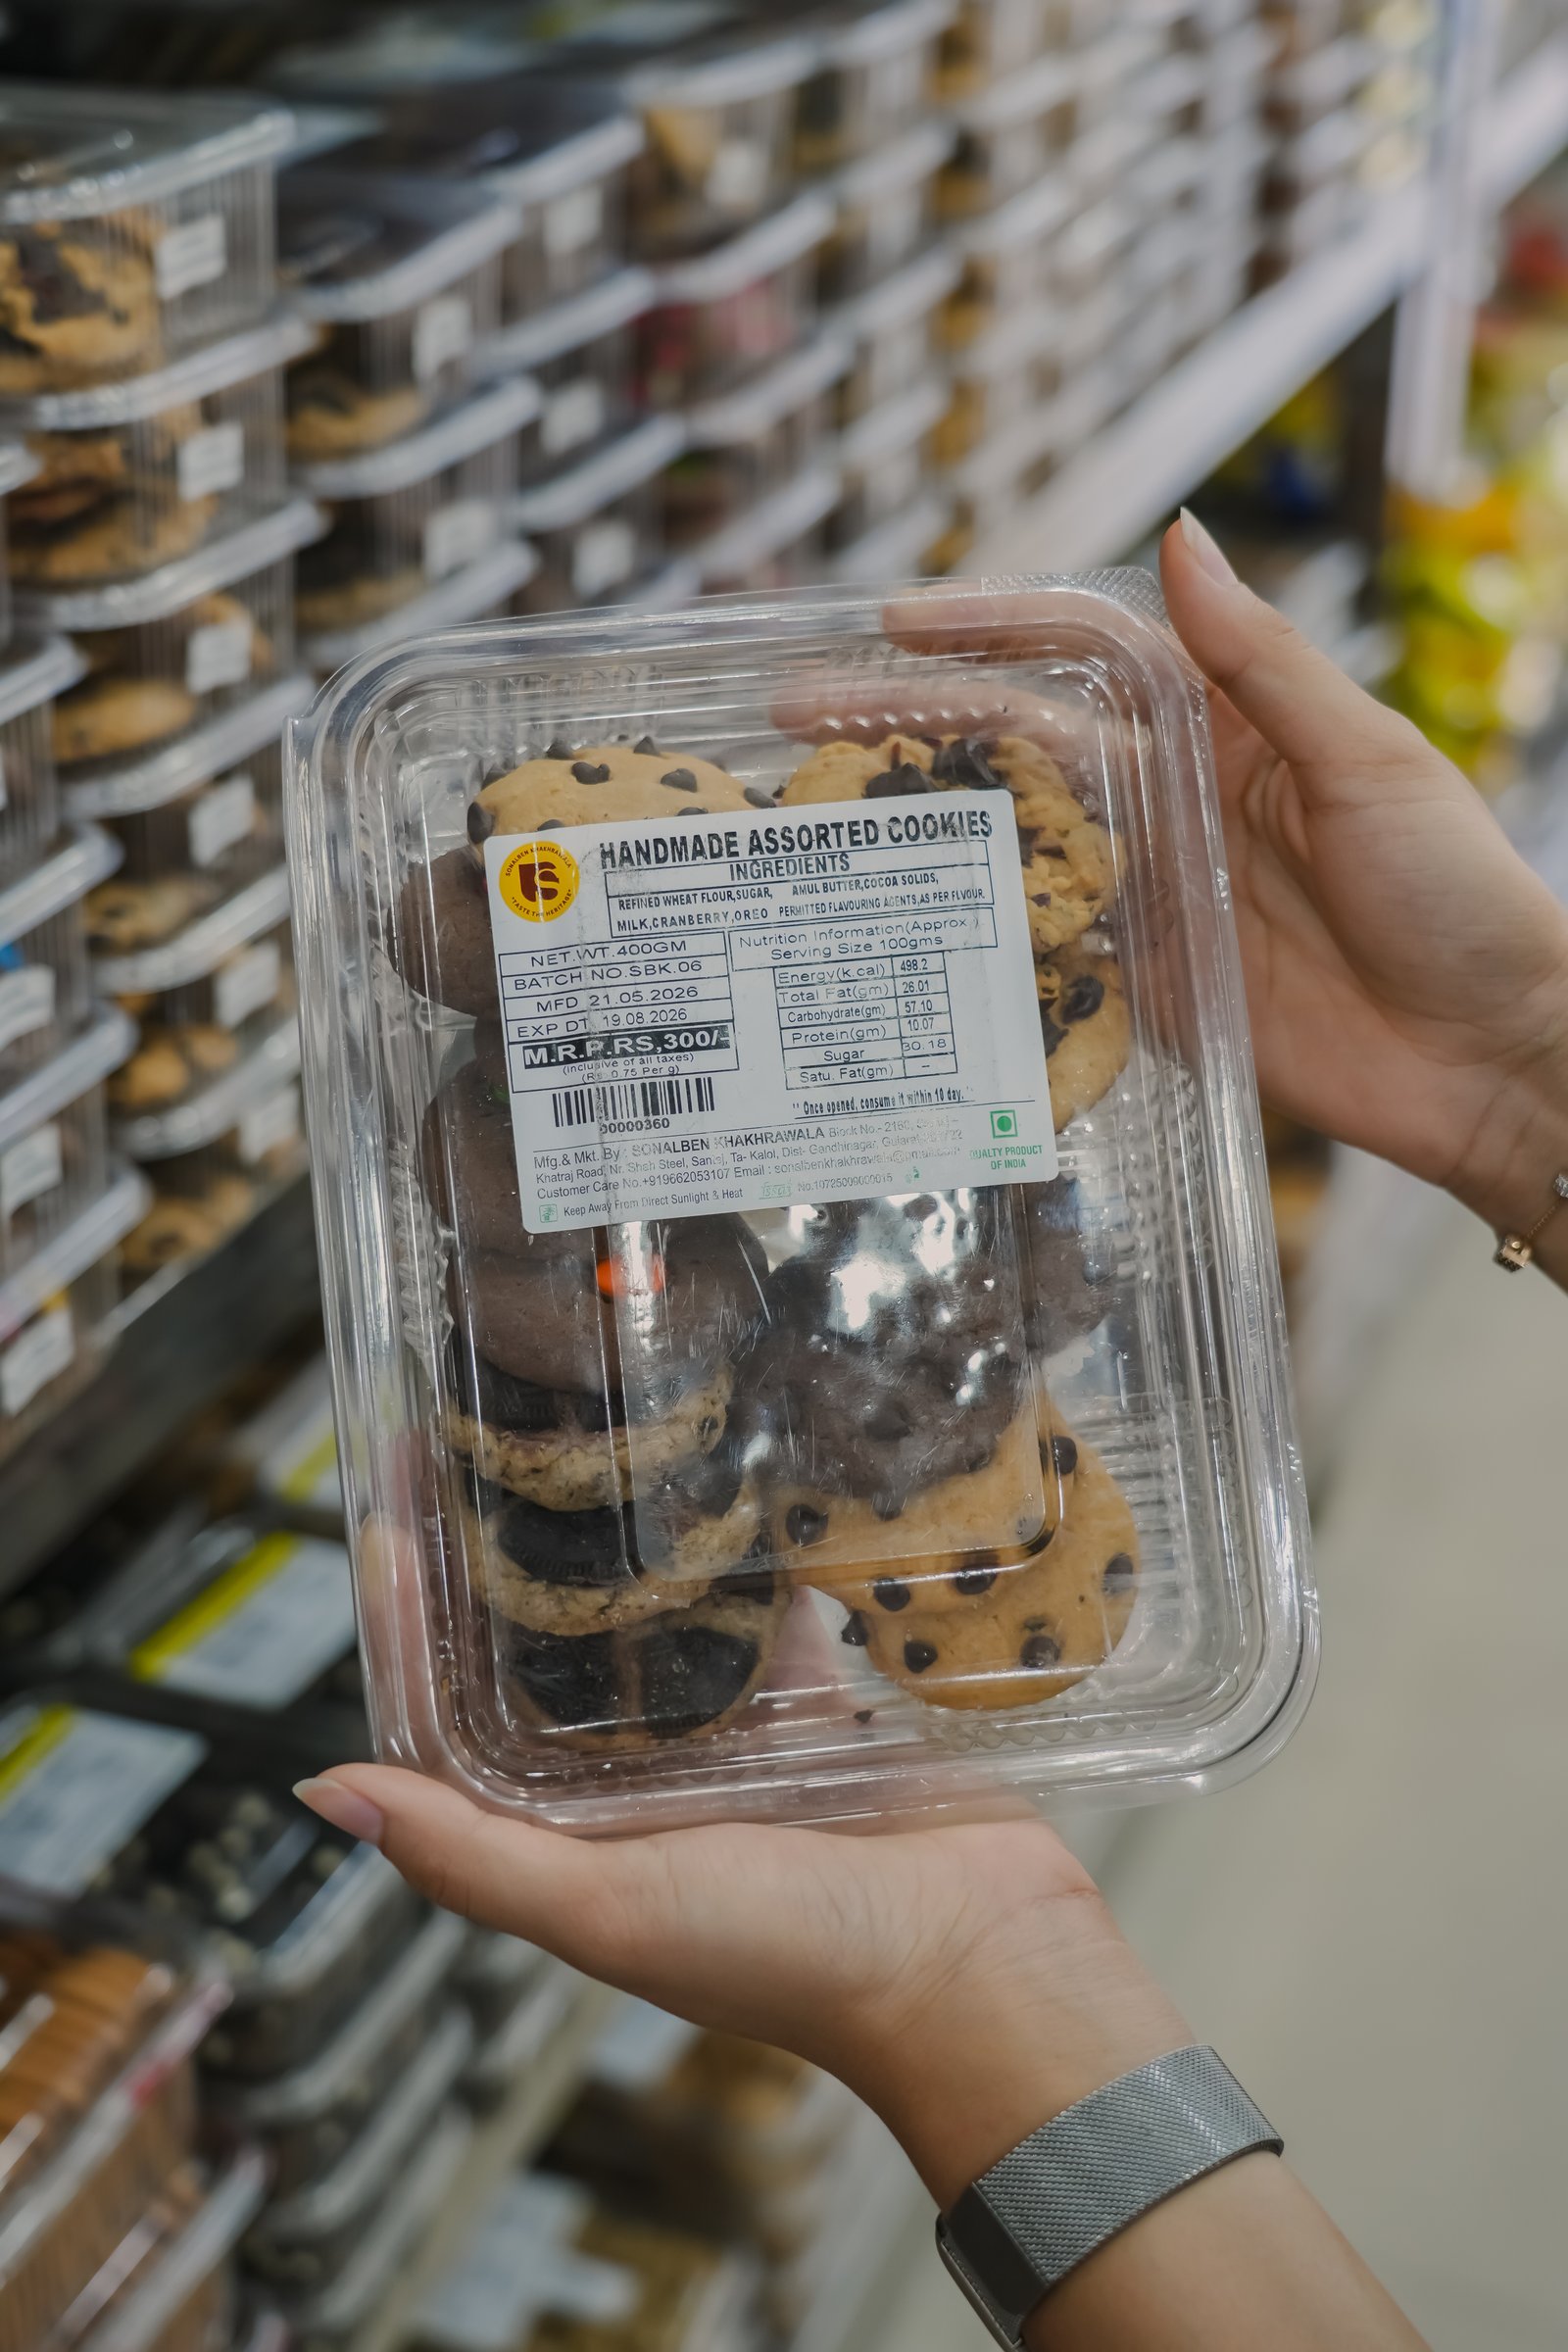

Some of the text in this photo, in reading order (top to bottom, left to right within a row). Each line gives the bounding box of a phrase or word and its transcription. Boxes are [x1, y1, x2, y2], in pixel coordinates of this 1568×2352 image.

[600, 810, 992, 869] HANDMADE ASSORTED COOKIES
[505, 851, 529, 877] SONALBEN
[729, 853, 850, 881] INGREDIENTS
[792, 872, 939, 896] AMUL BUTTER,COCOA SOLIDS,
[512, 899, 530, 915] TASTE
[545, 893, 572, 916] HERITAGE
[618, 887, 773, 910] REFINED WHEAT FLOUR,SUGAR,
[779, 902, 827, 917] PERMITTED
[829, 899, 881, 913] FLAVOURING
[932, 891, 950, 903] PER
[531, 940, 687, 967] NET.WT.400GM
[739, 933, 808, 949] Nutrition
[770, 935, 944, 960] Serving Size 100gms
[514, 960, 702, 991] BATCH NO.SBK.06
[778, 958, 928, 984] Energy(k.cal) 498.2
[537, 986, 699, 1013] MFD 21.05.2026
[778, 980, 930, 1004] Total Fat(gm) 26.01
[517, 1007, 688, 1038] EXP DT 19.08.2026
[787, 1000, 933, 1023] Carbohydrate(gm) 57.10
[792, 1017, 934, 1044] Protein(gm) 10.07
[623, 1057, 635, 1066] of
[639, 1056, 653, 1065] all
[657, 1053, 695, 1063] taxes)
[823, 1039, 947, 1063] Sugar 30.18
[642, 1065, 663, 1076] Per
[667, 1065, 680, 1075] g)
[800, 1070, 835, 1084] Satu.
[839, 1064, 894, 1081] Fat(gm)
[826, 1097, 858, 1114] opened,
[859, 1096, 896, 1110] consume
[898, 1092, 906, 1106] it
[906, 1089, 933, 1105] within
[934, 1088, 945, 1102] 10
[947, 1087, 964, 1104] day.
[574, 1150, 600, 1164] Mkt.
[603, 1147, 620, 1162] By
[631, 1138, 710, 1157] SONALBEN
[713, 1126, 825, 1150] KHAKHRAWALA
[1004, 1145, 1043, 1156] PRODUCT
[536, 1170, 574, 1184] Khatraj
[610, 1163, 625, 1174] Nr.
[659, 1157, 689, 1170] Steel,
[750, 1149, 779, 1160] Kalol,
[990, 1158, 1027, 1170] OF INDIA
[537, 1185, 590, 1200] Customer
[592, 1181, 619, 1193] Care
[733, 1164, 765, 1178] Email
[564, 1203, 586, 1217] Keep
[588, 1200, 612, 1214] Away
[614, 1200, 639, 1210] From
[641, 1195, 668, 1207] Direct
[670, 1191, 710, 1204] Sunlight
[721, 1187, 743, 1200] Heat
